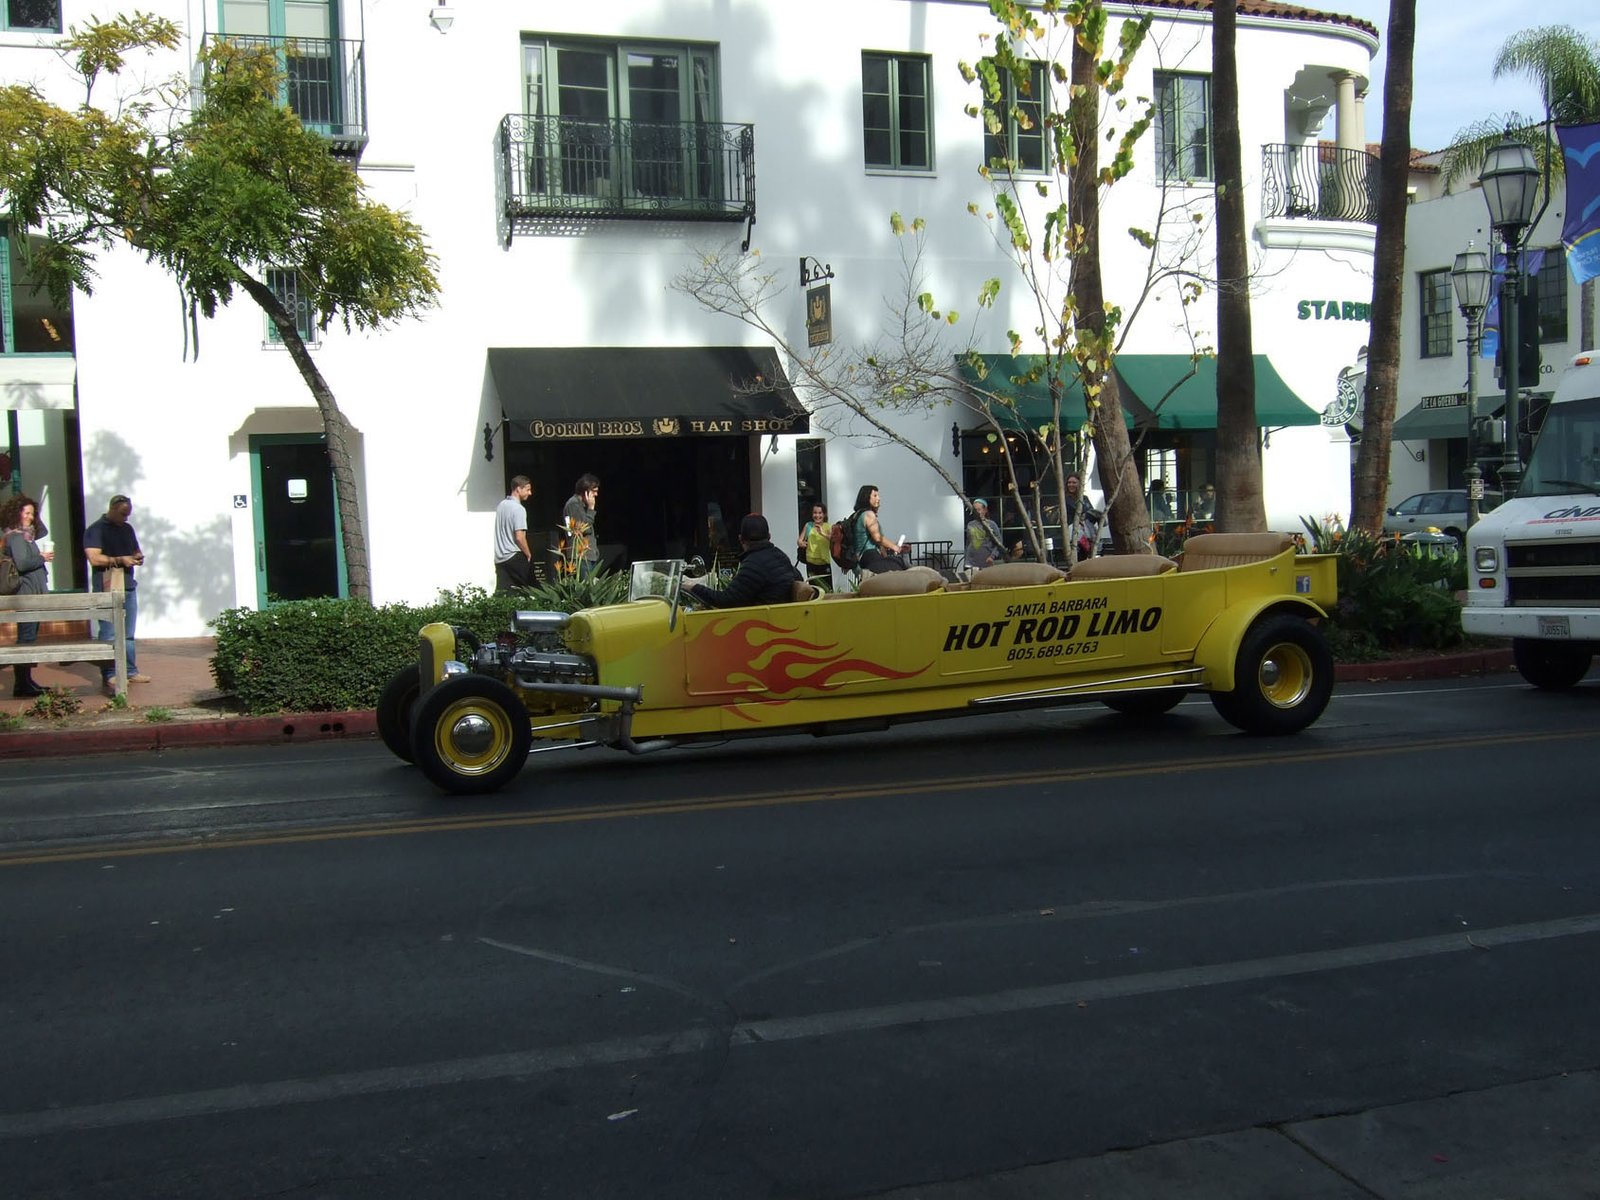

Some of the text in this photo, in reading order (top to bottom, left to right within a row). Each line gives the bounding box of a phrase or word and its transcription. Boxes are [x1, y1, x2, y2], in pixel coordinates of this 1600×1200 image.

[1430, 396, 1437, 408] LA
[1321, 411, 1351, 424] OFFEE
[529, 419, 794, 439] GOORIN BROS. HAT SHOP
[1004, 597, 1108, 617] SANTA BARBARA
[942, 607, 1163, 652] HOT ROD LIMO
[1006, 641, 1099, 661] 805.689.6763
